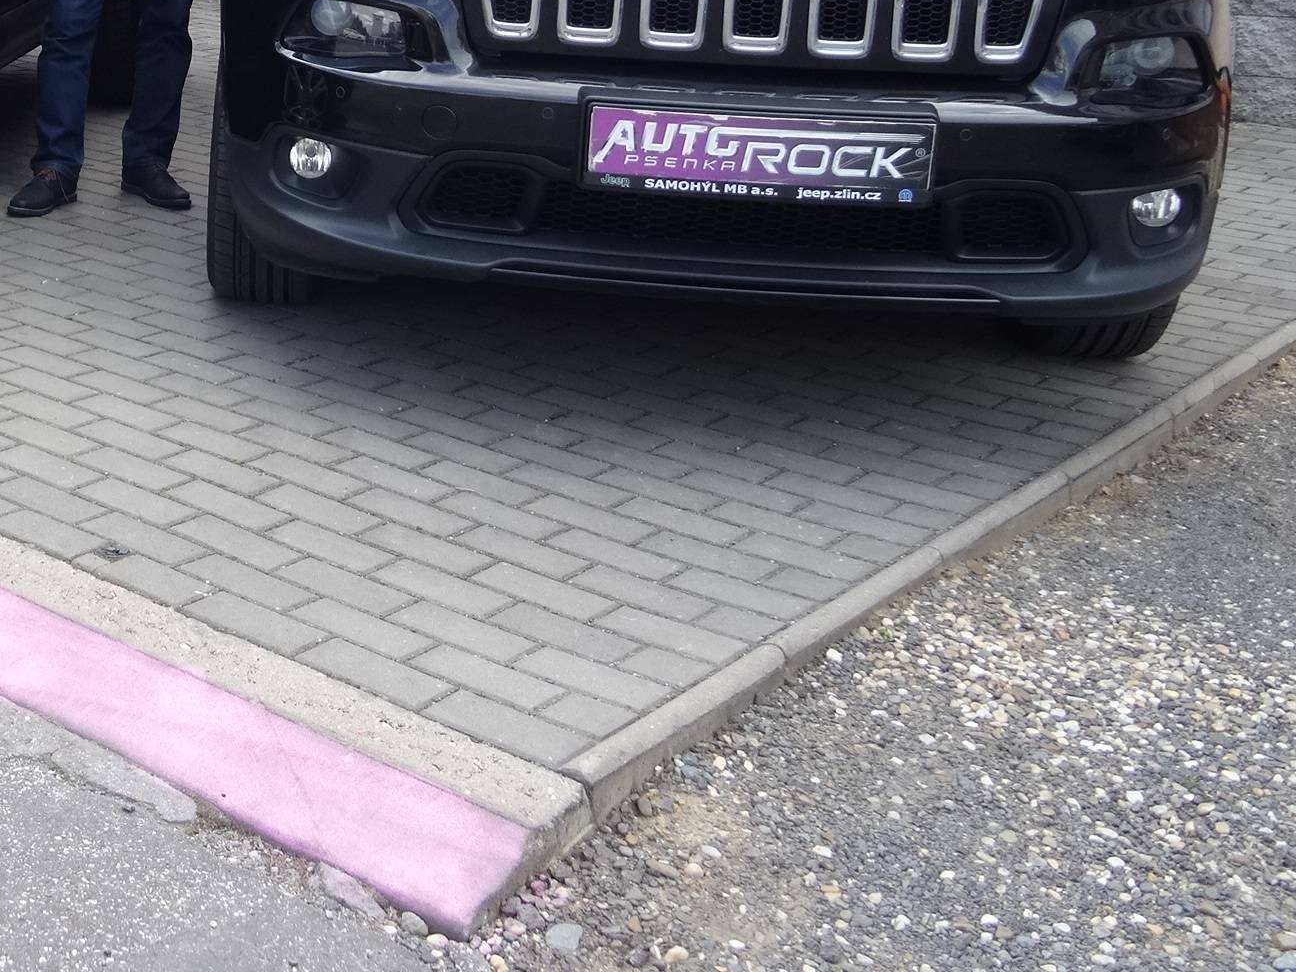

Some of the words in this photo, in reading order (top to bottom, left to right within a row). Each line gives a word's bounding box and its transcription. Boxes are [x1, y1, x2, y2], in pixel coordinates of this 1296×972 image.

[593, 119, 913, 178] AUTOROCK
[624, 155, 736, 171] PSENKA
[600, 174, 630, 187] Jeep
[644, 178, 720, 193] SAMOHÝL
[724, 184, 748, 194] MB
[751, 185, 778, 196] a.s.
[796, 186, 881, 201] jeep.zlin.cz
